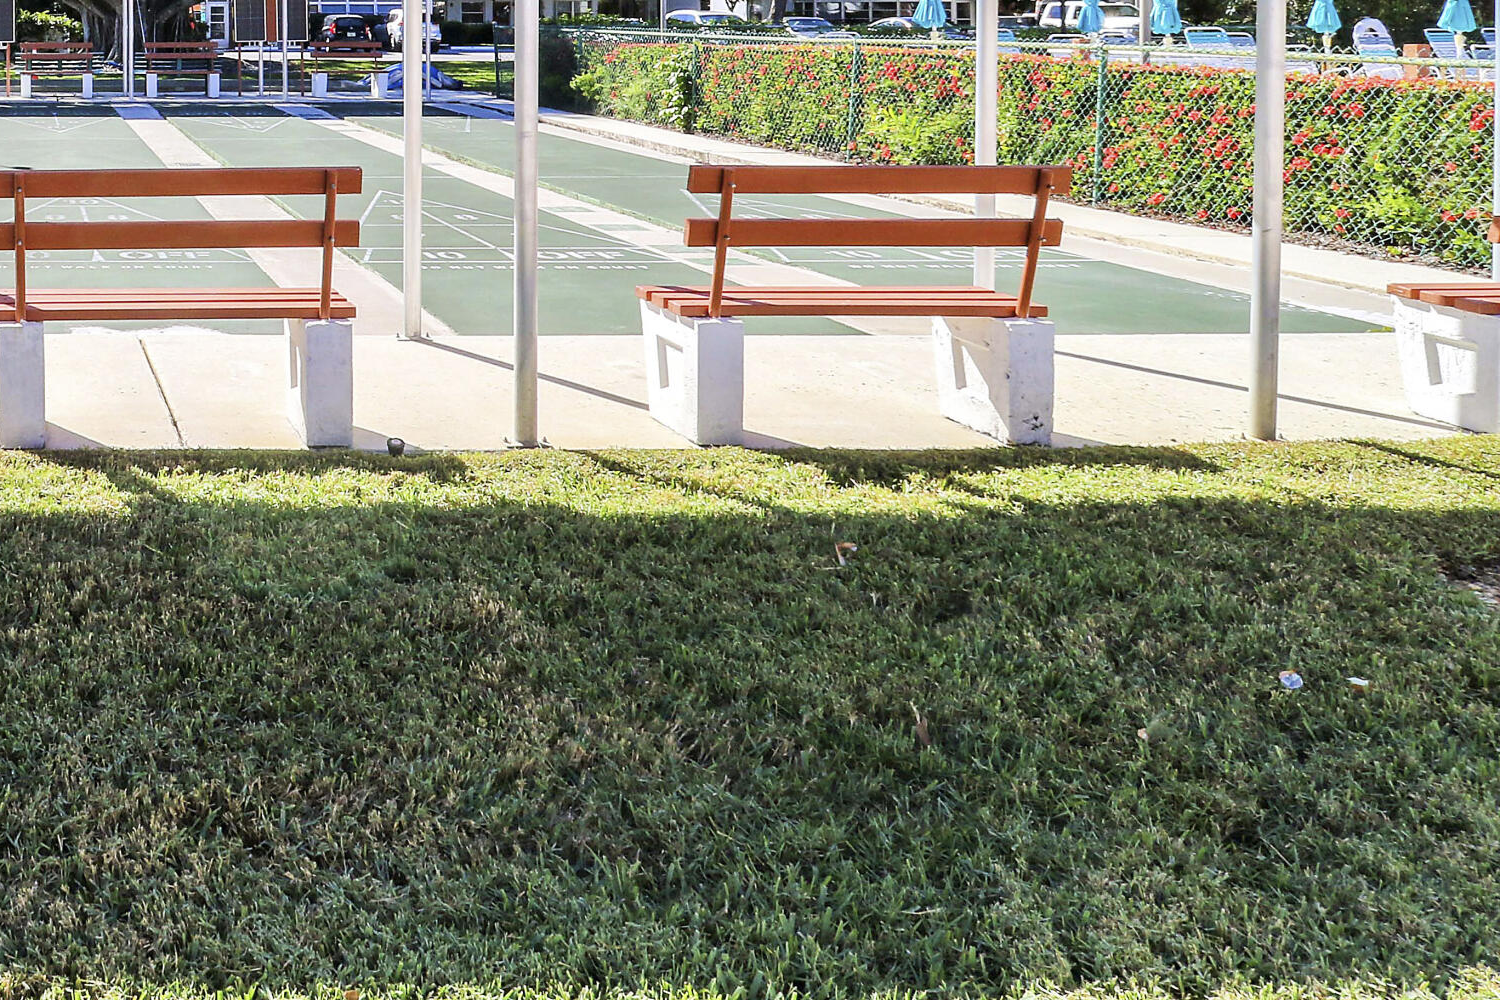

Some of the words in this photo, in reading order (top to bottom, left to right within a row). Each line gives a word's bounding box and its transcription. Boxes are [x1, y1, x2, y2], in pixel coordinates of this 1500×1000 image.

[118, 251, 212, 259] OFF
[422, 251, 468, 260] 10
[537, 251, 626, 260] OFF
[825, 250, 882, 259] 10
